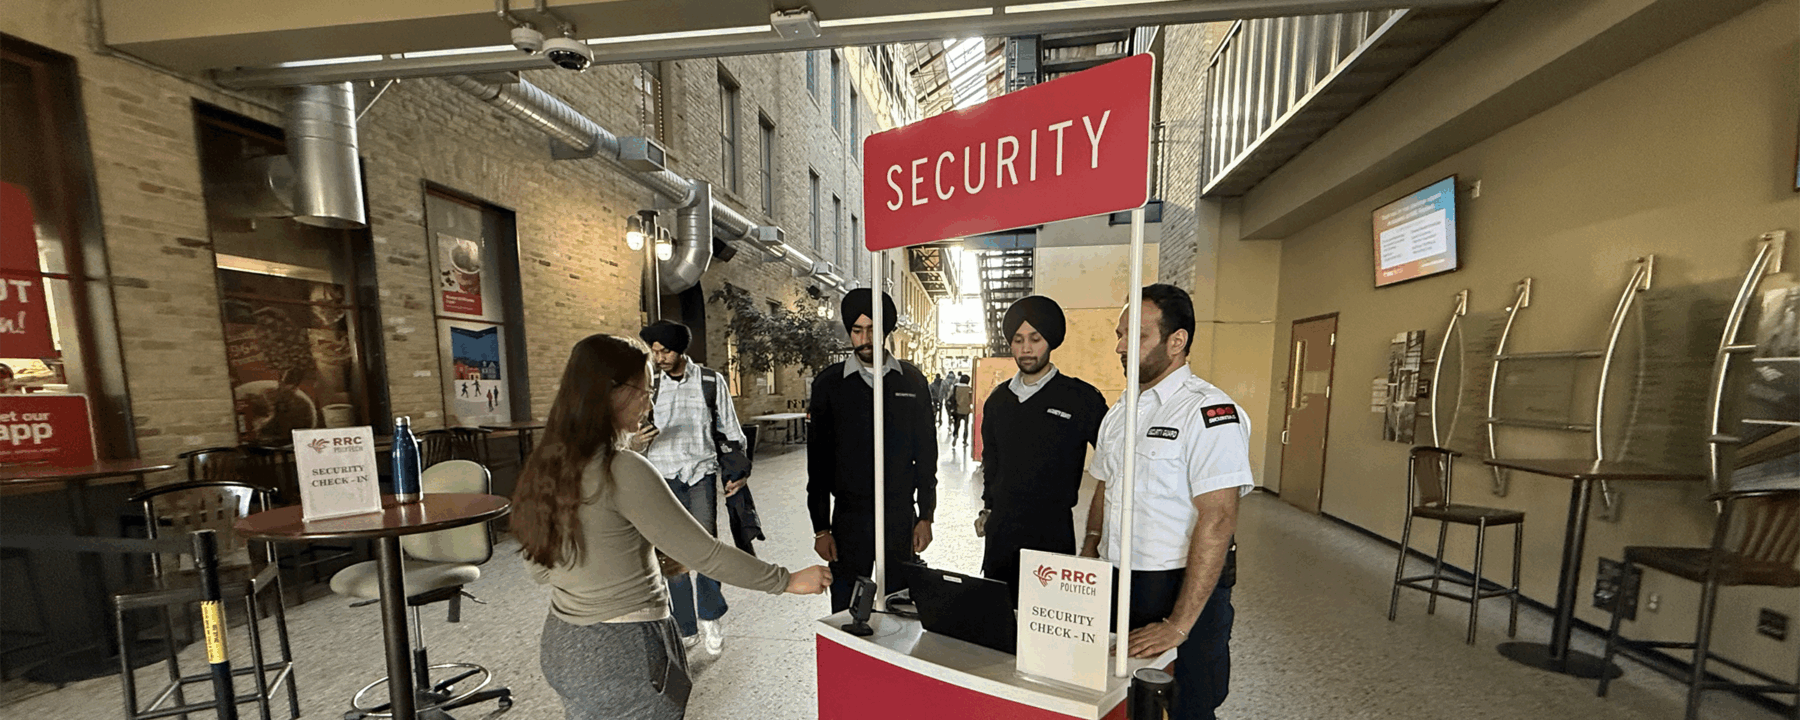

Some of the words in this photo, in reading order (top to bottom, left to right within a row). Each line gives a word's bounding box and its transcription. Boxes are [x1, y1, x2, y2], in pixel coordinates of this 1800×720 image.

[886, 109, 1111, 211] SECURITY
[21, 412, 50, 421] our
[0, 422, 53, 446] app
[333, 437, 362, 446] RRC
[312, 465, 364, 476] SECURITY
[312, 477, 349, 487] CHECK
[1061, 568, 1097, 585] RRC
[1060, 583, 1097, 596] POLYTECH
[1032, 606, 1095, 627] SECURITY
[1029, 621, 1071, 639] CHECK
